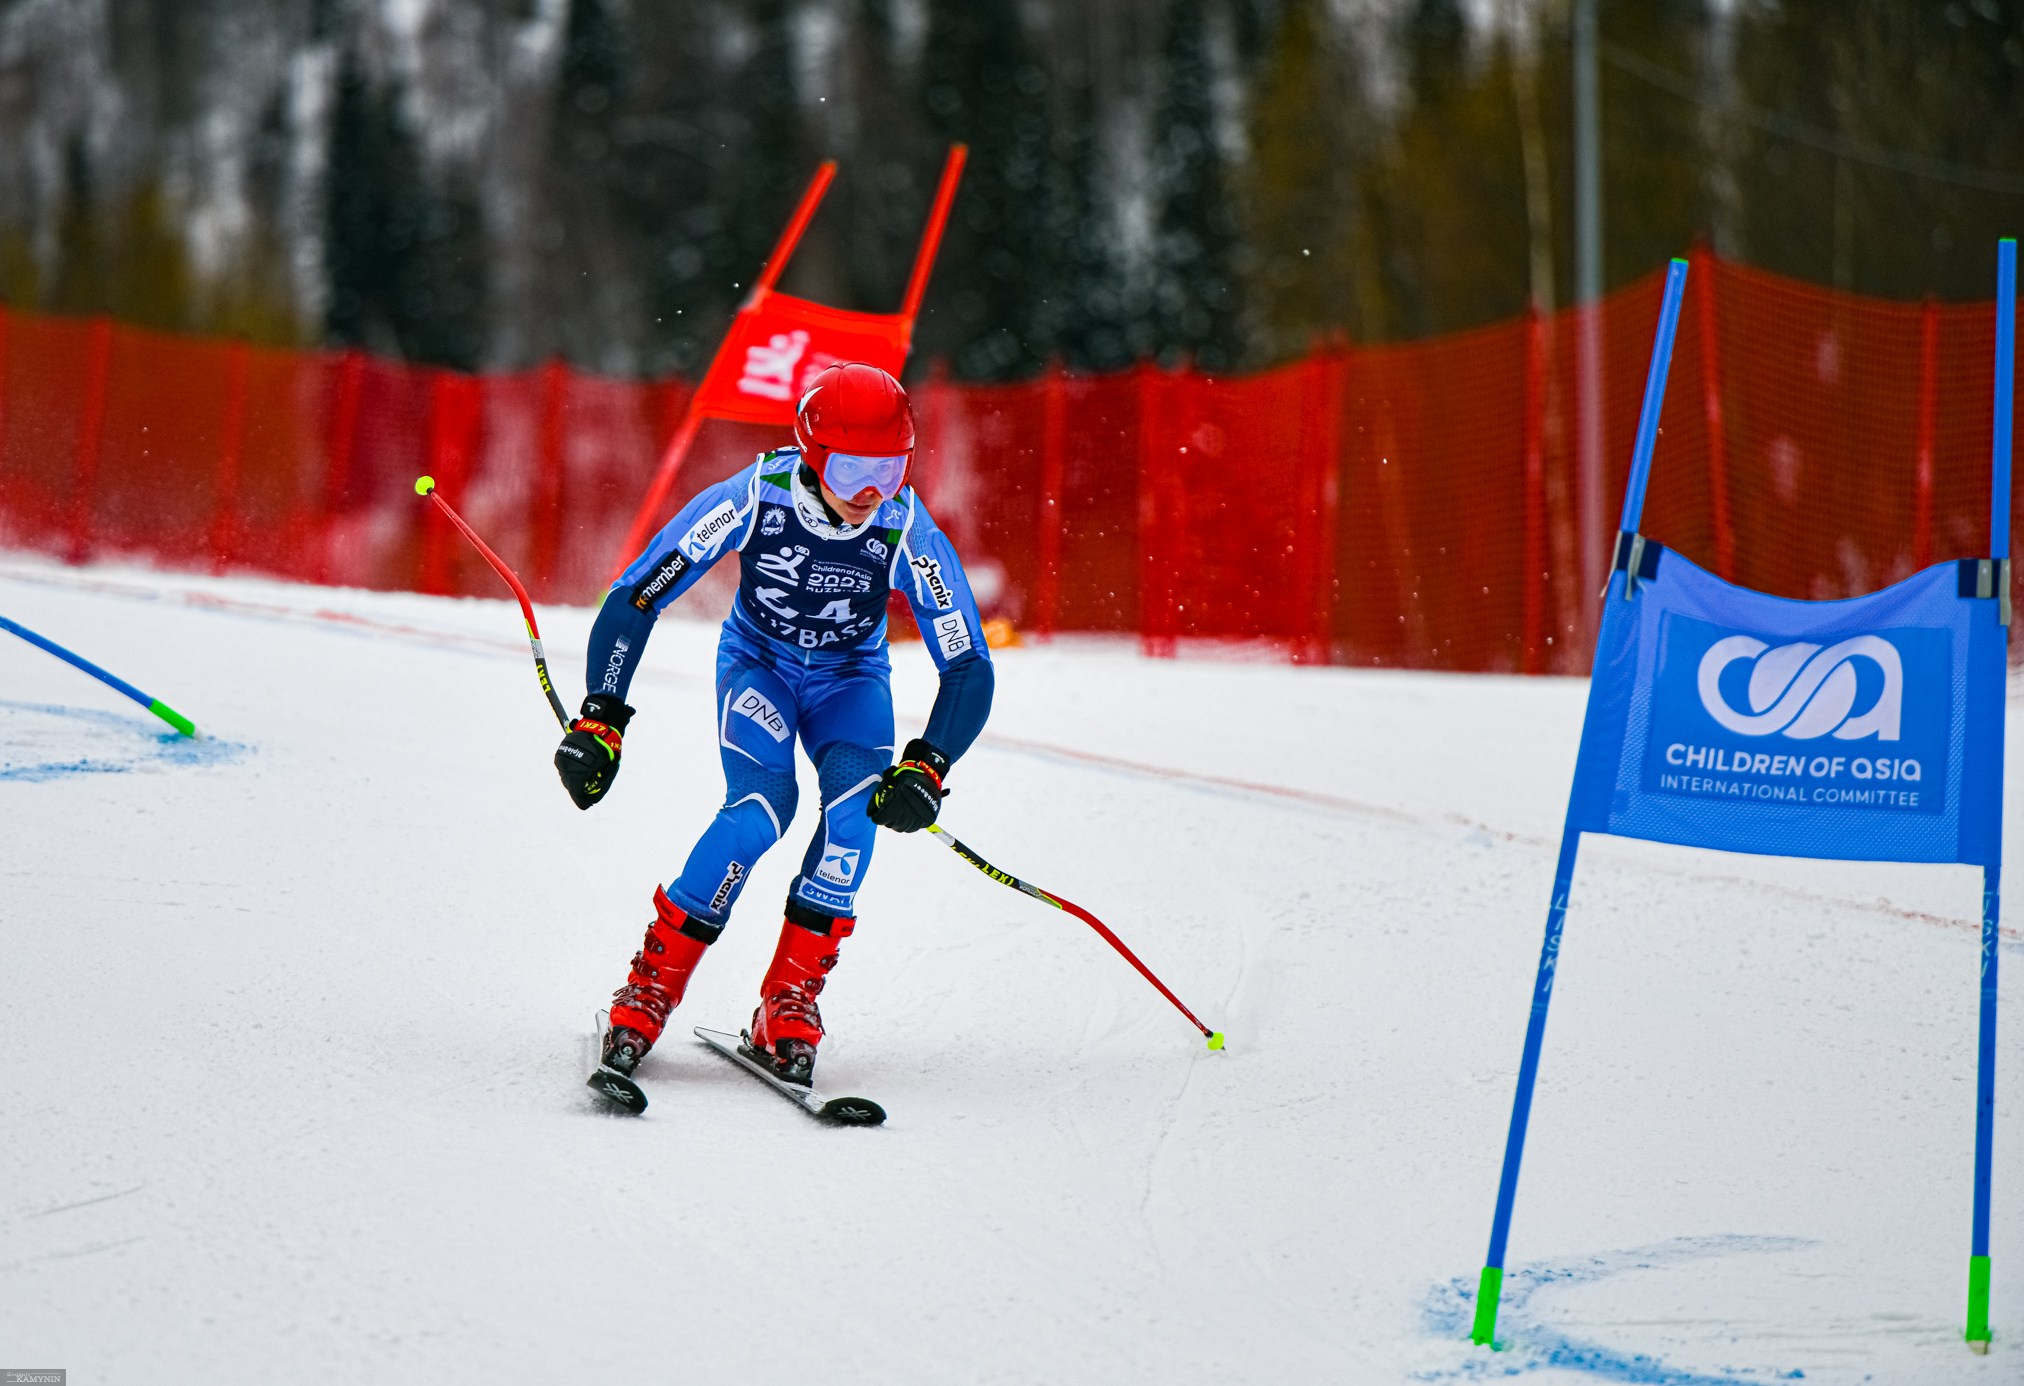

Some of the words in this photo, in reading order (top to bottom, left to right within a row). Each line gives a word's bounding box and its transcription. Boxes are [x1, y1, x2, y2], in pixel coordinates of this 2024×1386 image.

[696, 508, 736, 543] telenor
[807, 573, 871, 591] 2023
[811, 564, 846, 574] Children
[846, 568, 854, 576] of
[854, 571, 872, 581] Asia
[911, 556, 950, 608] phenix
[937, 619, 969, 652] DNB
[536, 664, 551, 693] LEKI
[602, 649, 626, 693] NORGE
[579, 720, 607, 732] LEKI
[742, 695, 783, 731] DNB
[1665, 743, 1807, 777] CHILDREN
[1809, 756, 1846, 778] OF
[1660, 774, 1808, 801] INTERNATIONAL
[1813, 788, 1920, 806] COMMITTEE
[711, 862, 743, 910] phenix
[819, 869, 850, 884] telenor
